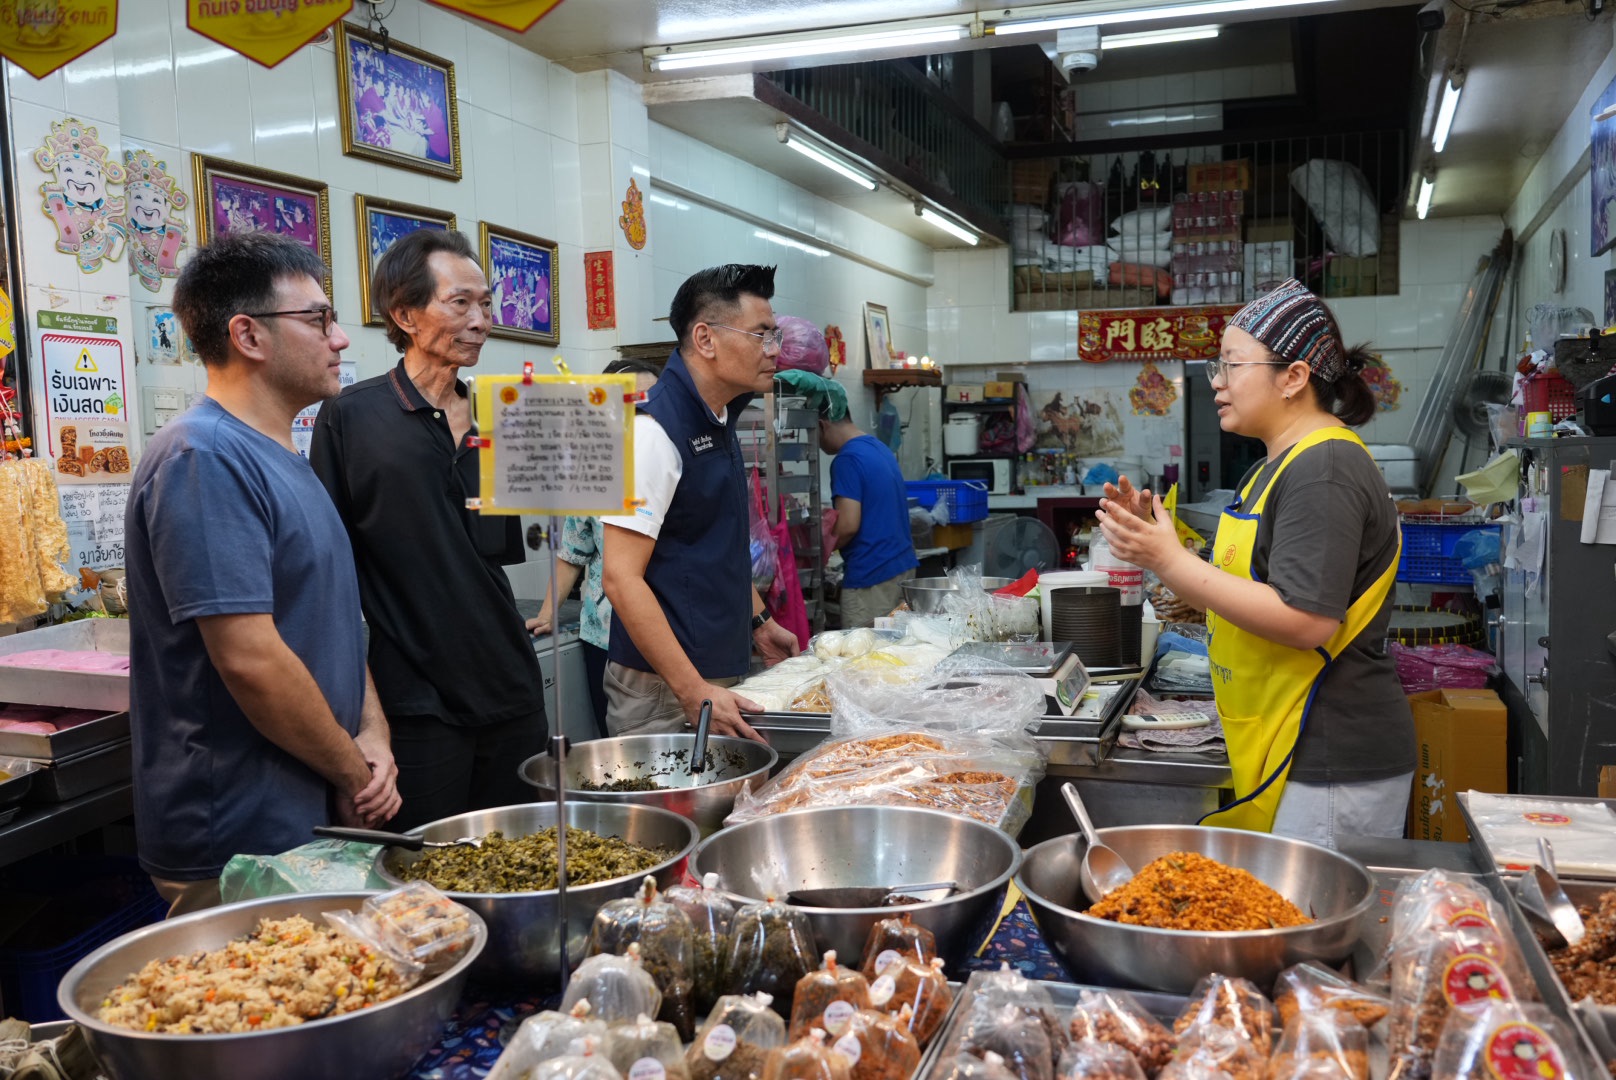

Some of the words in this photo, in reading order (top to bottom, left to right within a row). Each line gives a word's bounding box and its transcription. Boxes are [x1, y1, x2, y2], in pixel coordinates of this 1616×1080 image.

[593, 259, 608, 315] 生意興隆
[51, 369, 117, 391] รับเฉพาะ
[53, 393, 104, 414] เงินสด
